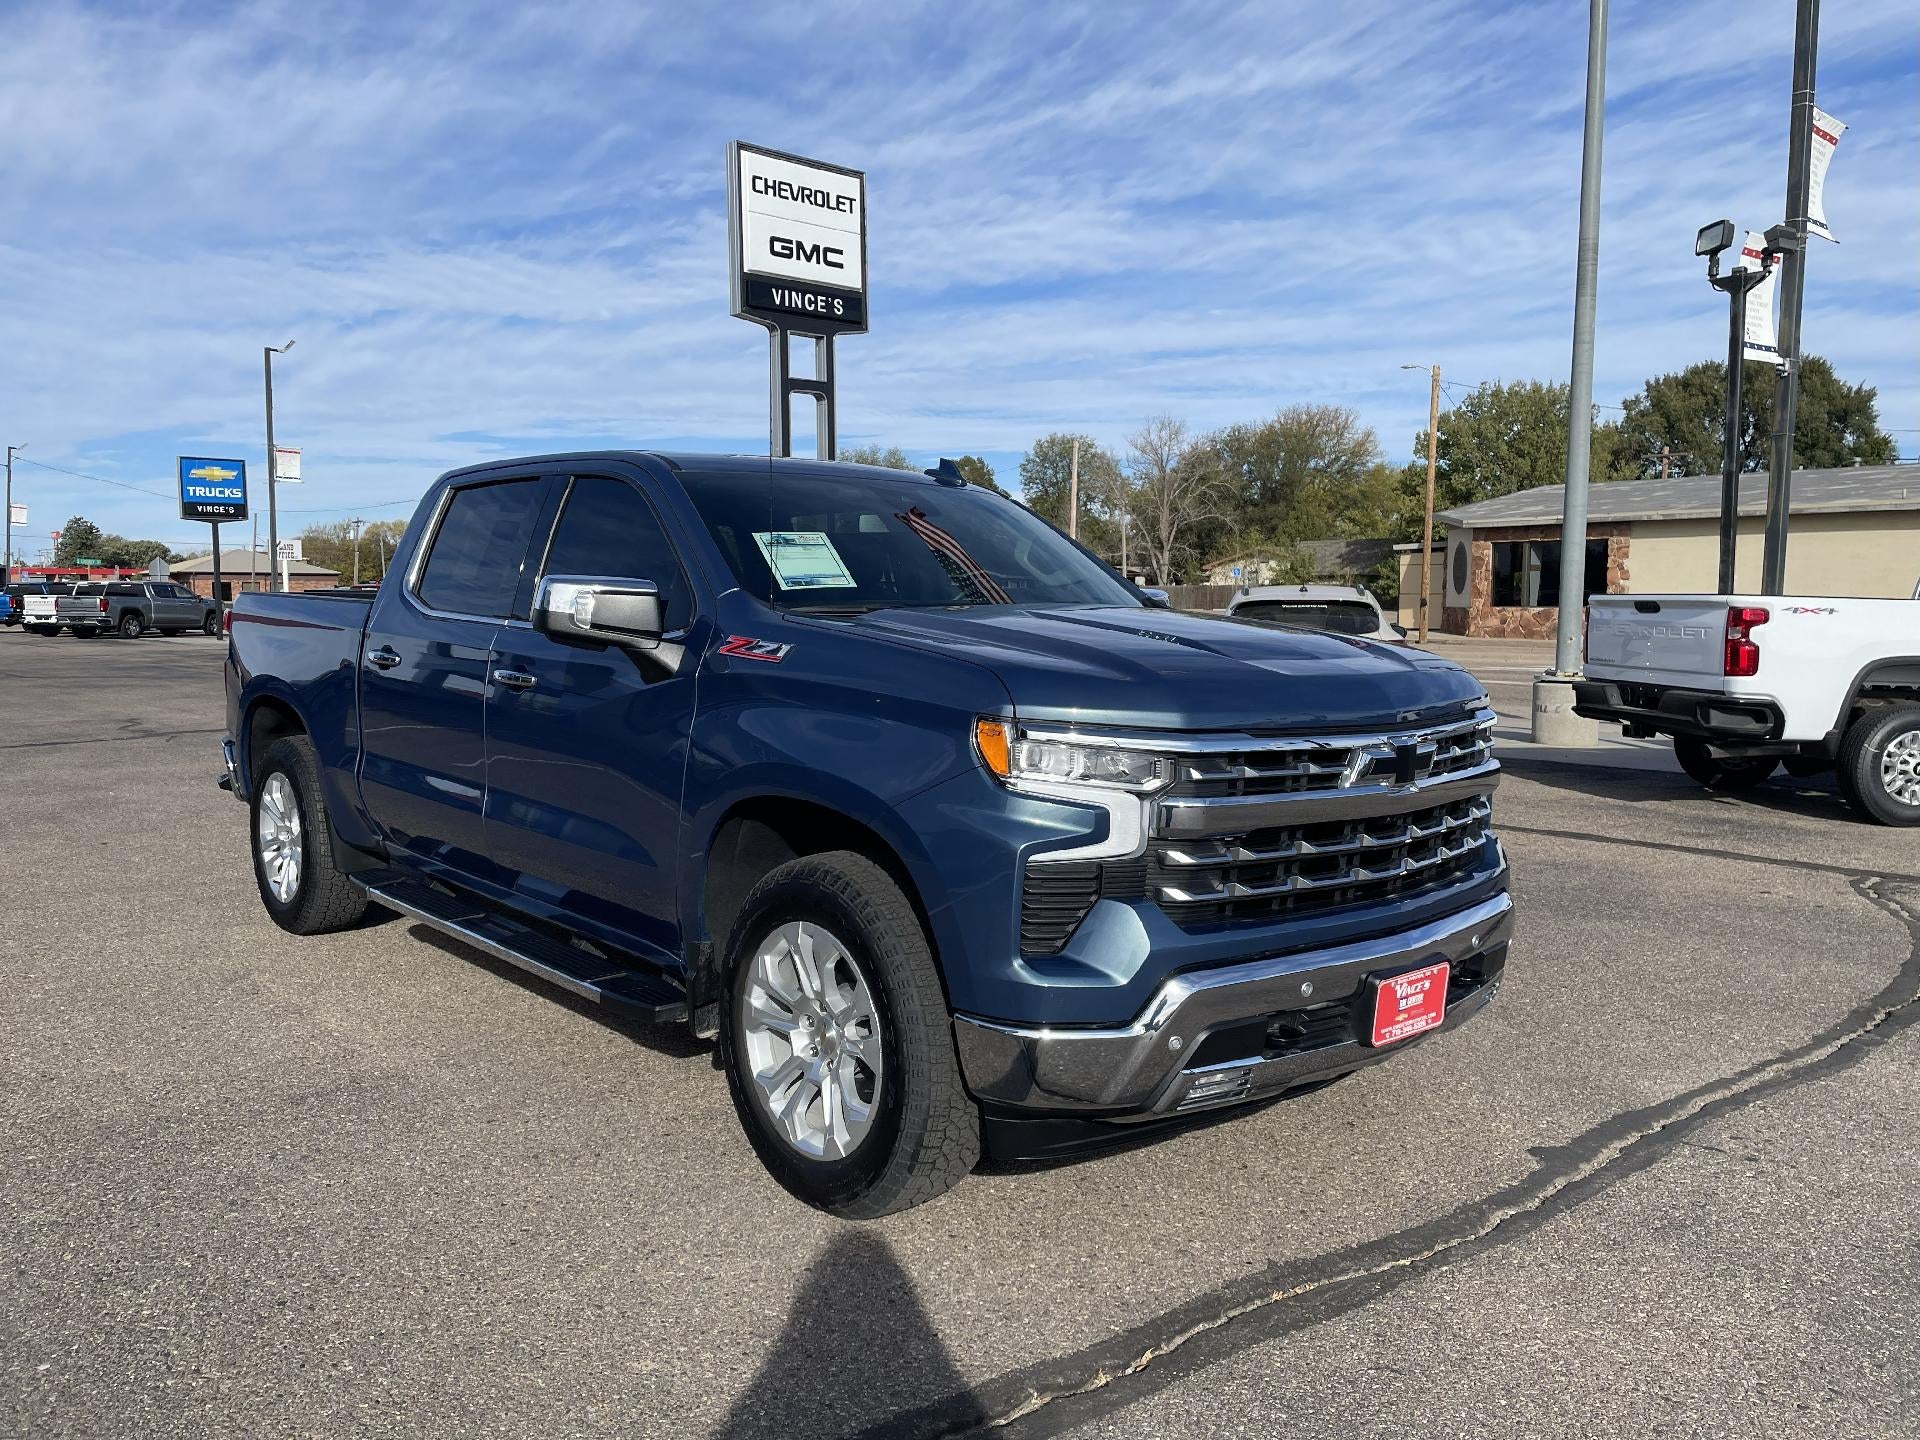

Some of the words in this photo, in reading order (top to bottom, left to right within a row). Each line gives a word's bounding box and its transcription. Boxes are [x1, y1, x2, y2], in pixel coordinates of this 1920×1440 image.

[752, 175, 856, 214] CHEVROLET
[769, 235, 844, 269] GMC
[772, 288, 844, 315] VINCE'S
[187, 486, 242, 498] TRUCKS
[197, 505, 235, 514] VINCE'S
[717, 634, 794, 663] Z71
[1395, 979, 1431, 998] VINCE'S
